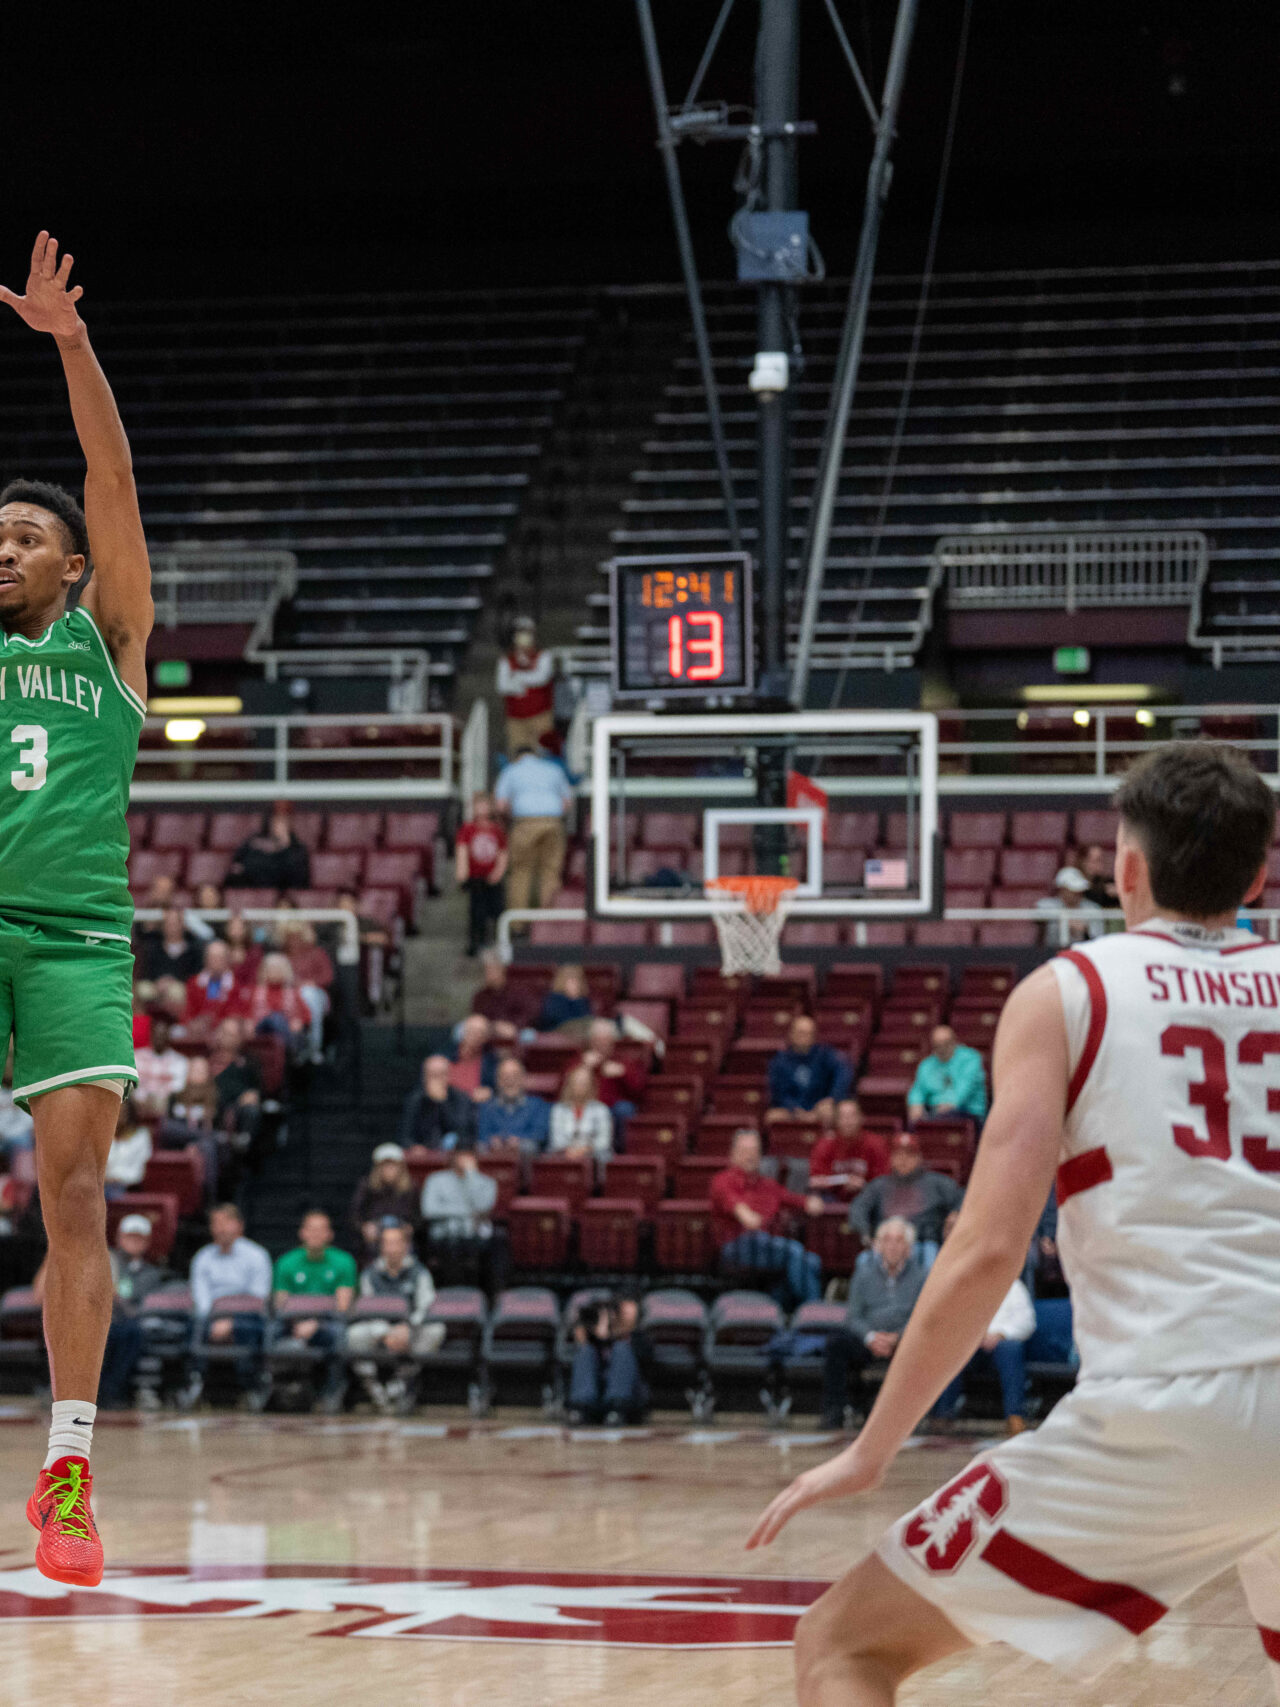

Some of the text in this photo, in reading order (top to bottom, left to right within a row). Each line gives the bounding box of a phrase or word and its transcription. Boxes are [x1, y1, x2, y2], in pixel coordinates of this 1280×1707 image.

[642, 571, 734, 608] 12:41
[668, 611, 724, 680] 13
[17, 664, 103, 719] VALLEY
[10, 724, 49, 791] 3
[1145, 964, 1280, 1008] STINSO
[1160, 1024, 1280, 1173] 33
